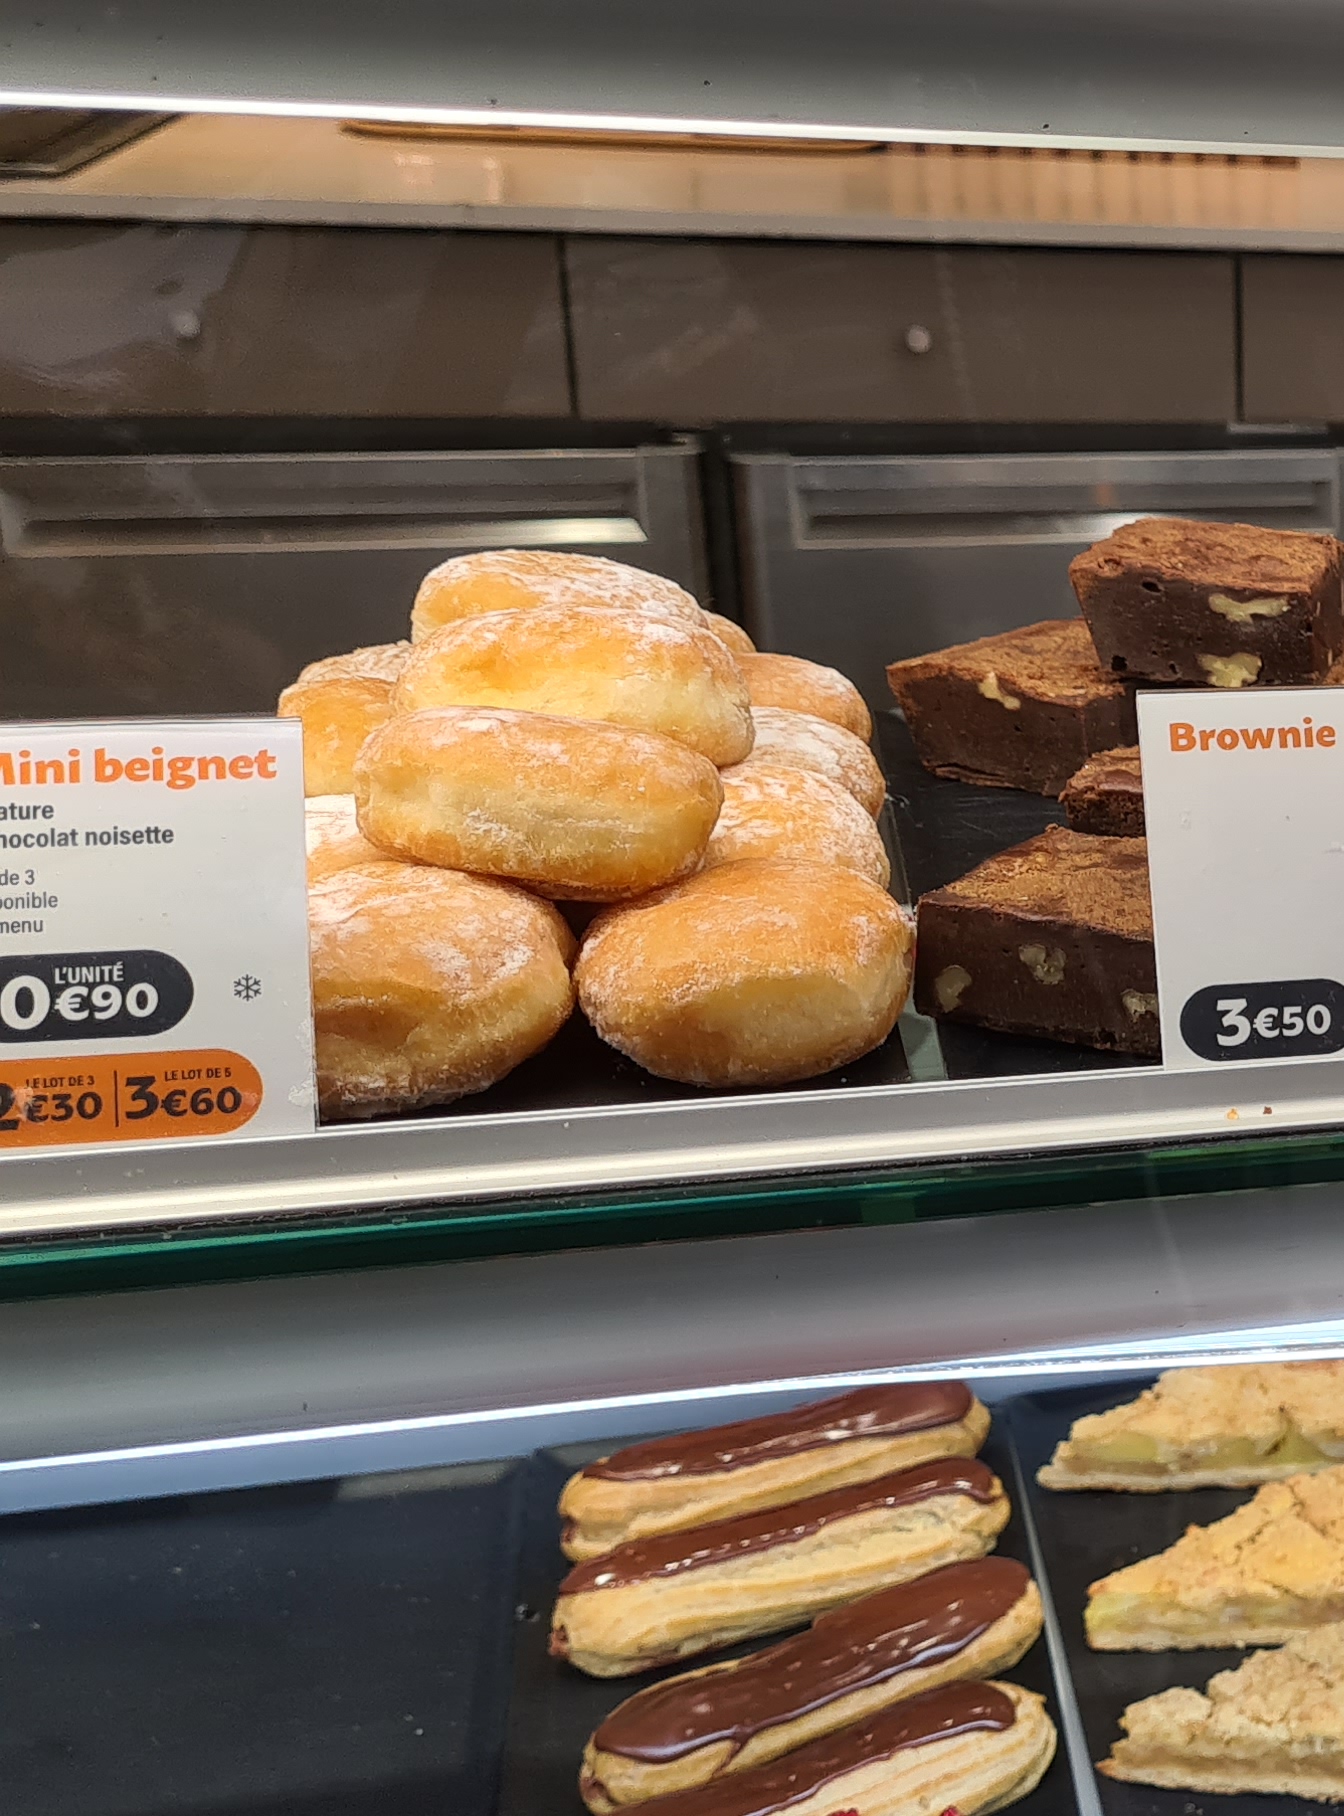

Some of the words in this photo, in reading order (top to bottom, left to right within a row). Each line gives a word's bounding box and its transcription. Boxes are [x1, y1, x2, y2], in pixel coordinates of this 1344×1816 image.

[1169, 717, 1336, 752] Brownie
[94, 747, 278, 790] beignet
[85, 825, 175, 846] noisette
[24, 869, 35, 885] 3
[54, 962, 124, 984] L'UNITÉ
[0, 974, 159, 1031] 0€90
[1216, 998, 1332, 1047] 3€50
[43, 1077, 64, 1087] LOT
[68, 1076, 84, 1086] DE
[87, 1075, 95, 1086] 3
[164, 1070, 177, 1081] LE
[181, 1069, 202, 1080] LOT
[206, 1068, 222, 1079] DE
[225, 1067, 232, 1078] 5
[125, 1076, 243, 1120] 3€60
